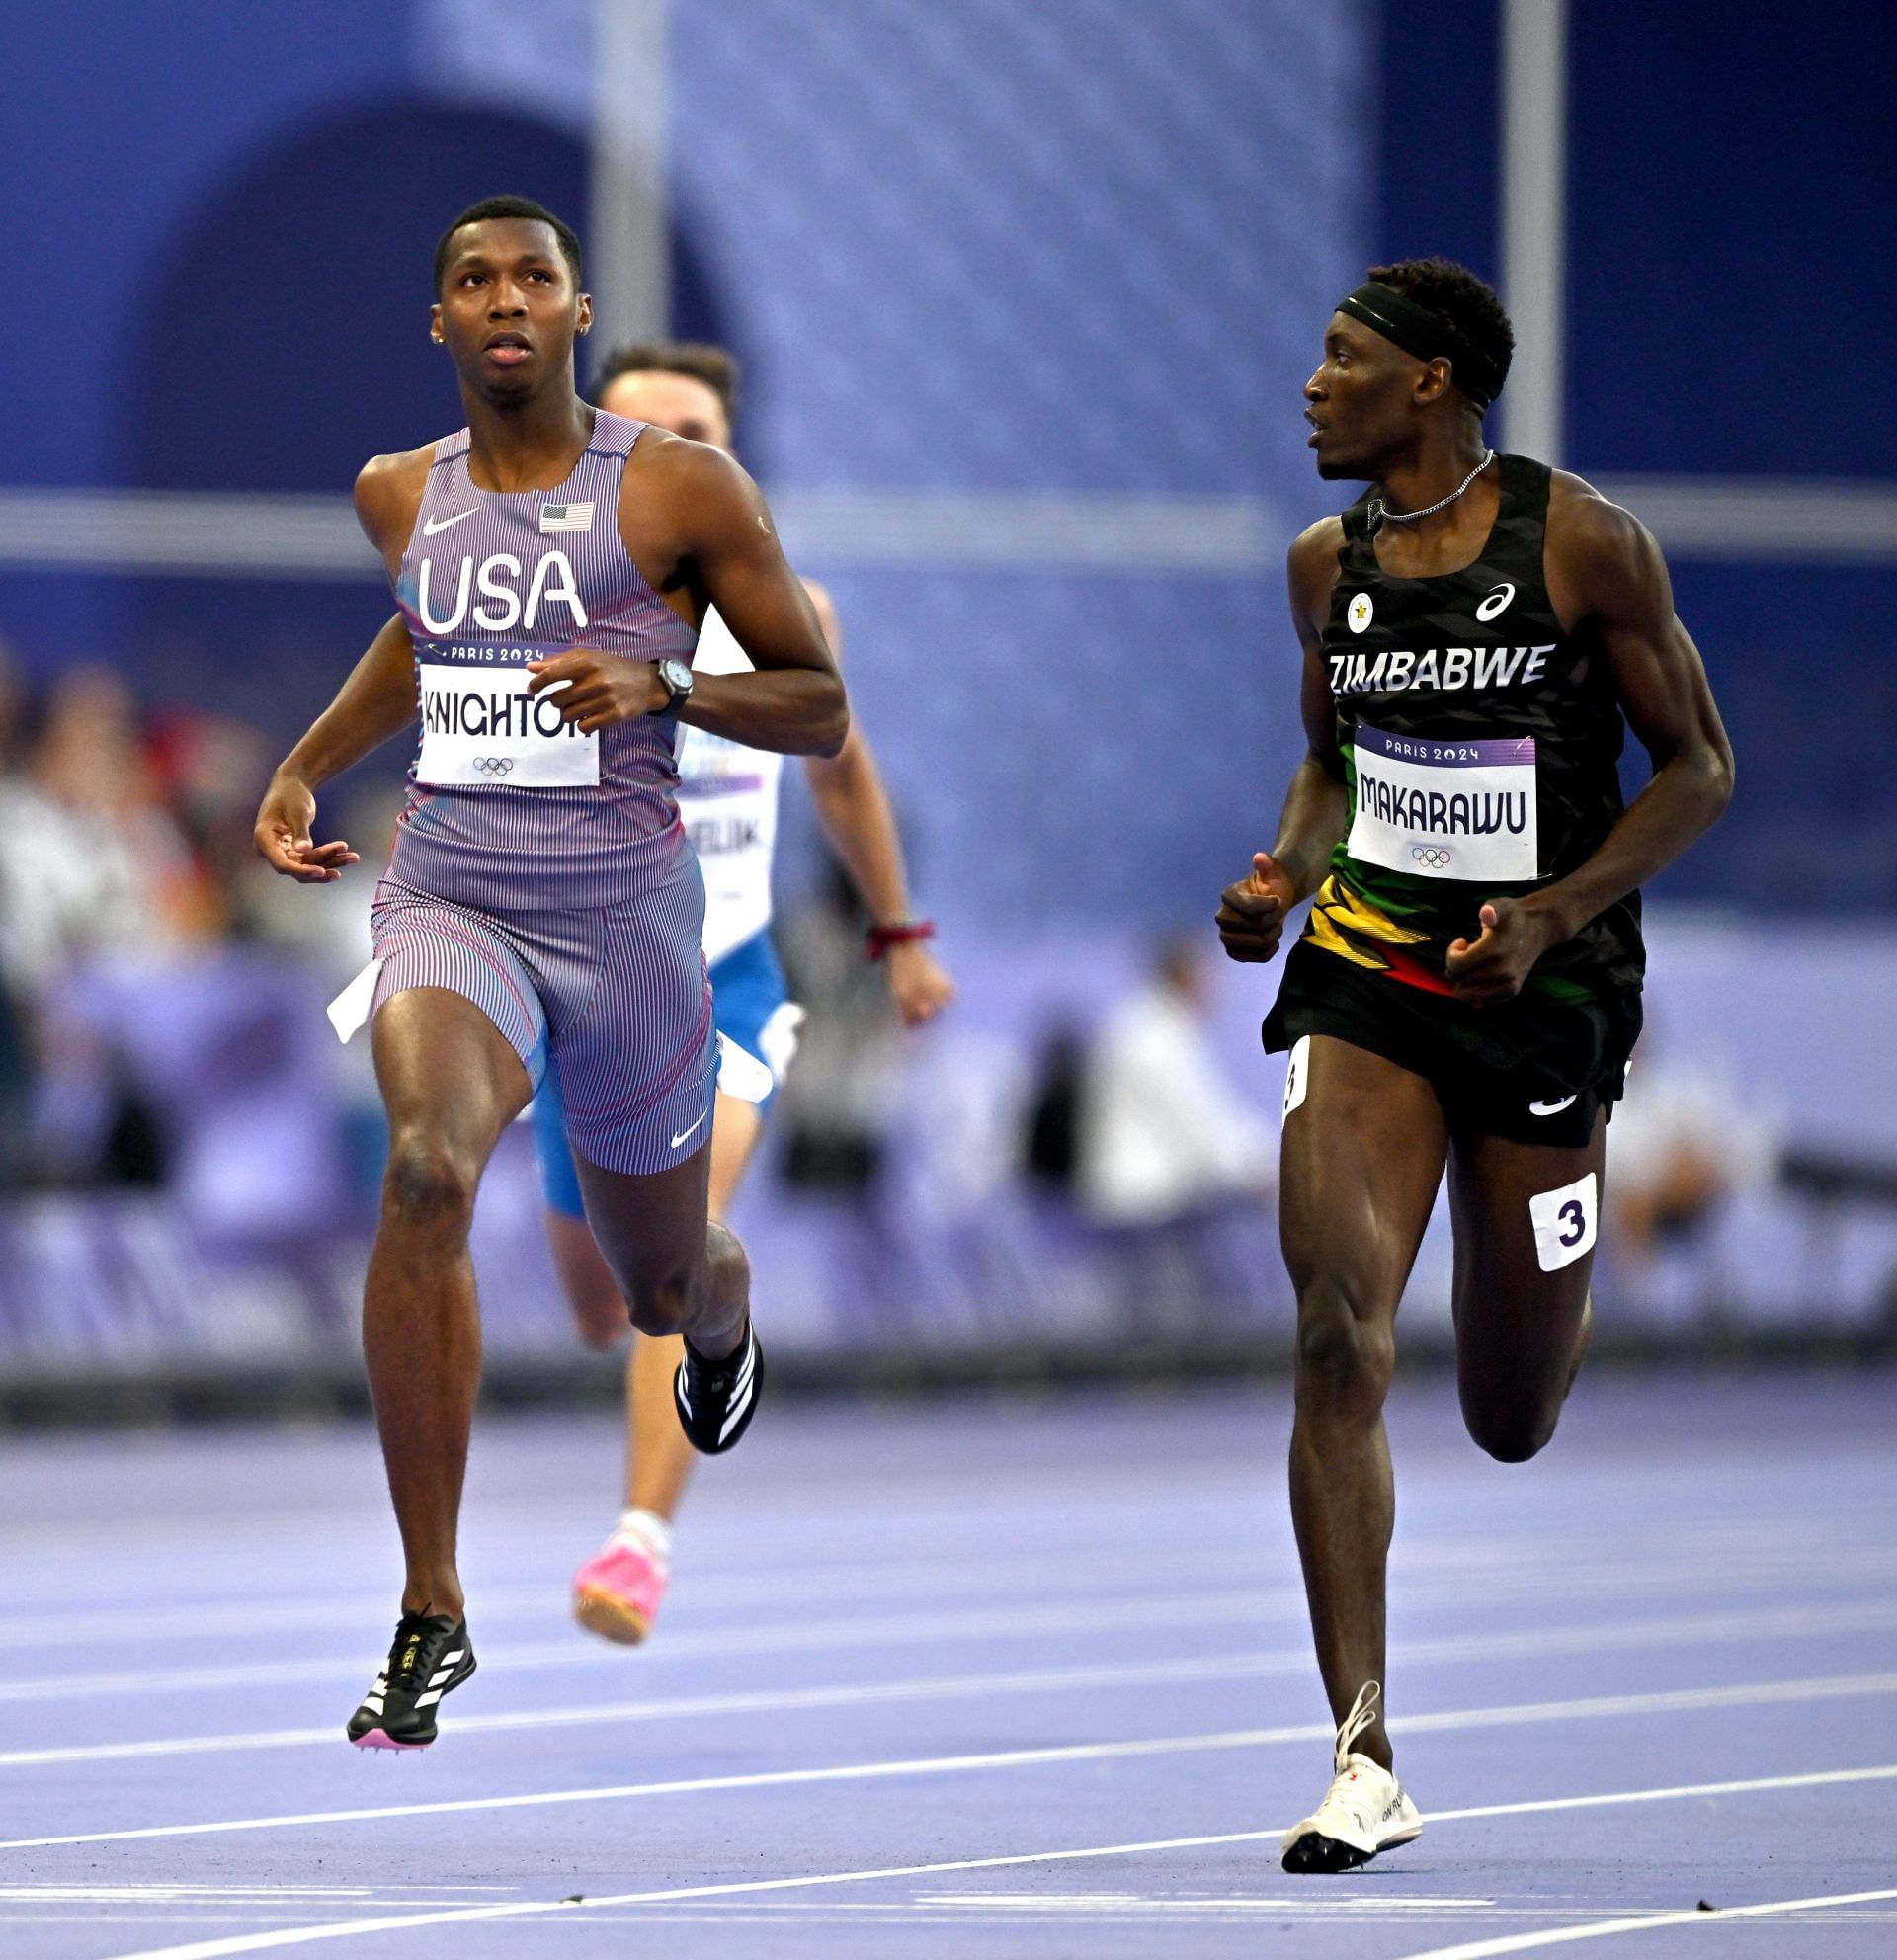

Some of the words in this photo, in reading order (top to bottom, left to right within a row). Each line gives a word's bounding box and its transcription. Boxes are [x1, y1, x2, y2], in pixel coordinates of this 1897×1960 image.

[419, 550, 588, 634] USA
[451, 646, 494, 661] PARIS
[500, 648, 544, 662] 2024
[1330, 644, 1557, 695] ZIMBABWE
[1385, 739, 1428, 759] PARIS
[1433, 748, 1479, 761] 2024
[1360, 773, 1526, 836] MAKARAWU
[1557, 1199, 1586, 1248] 3
